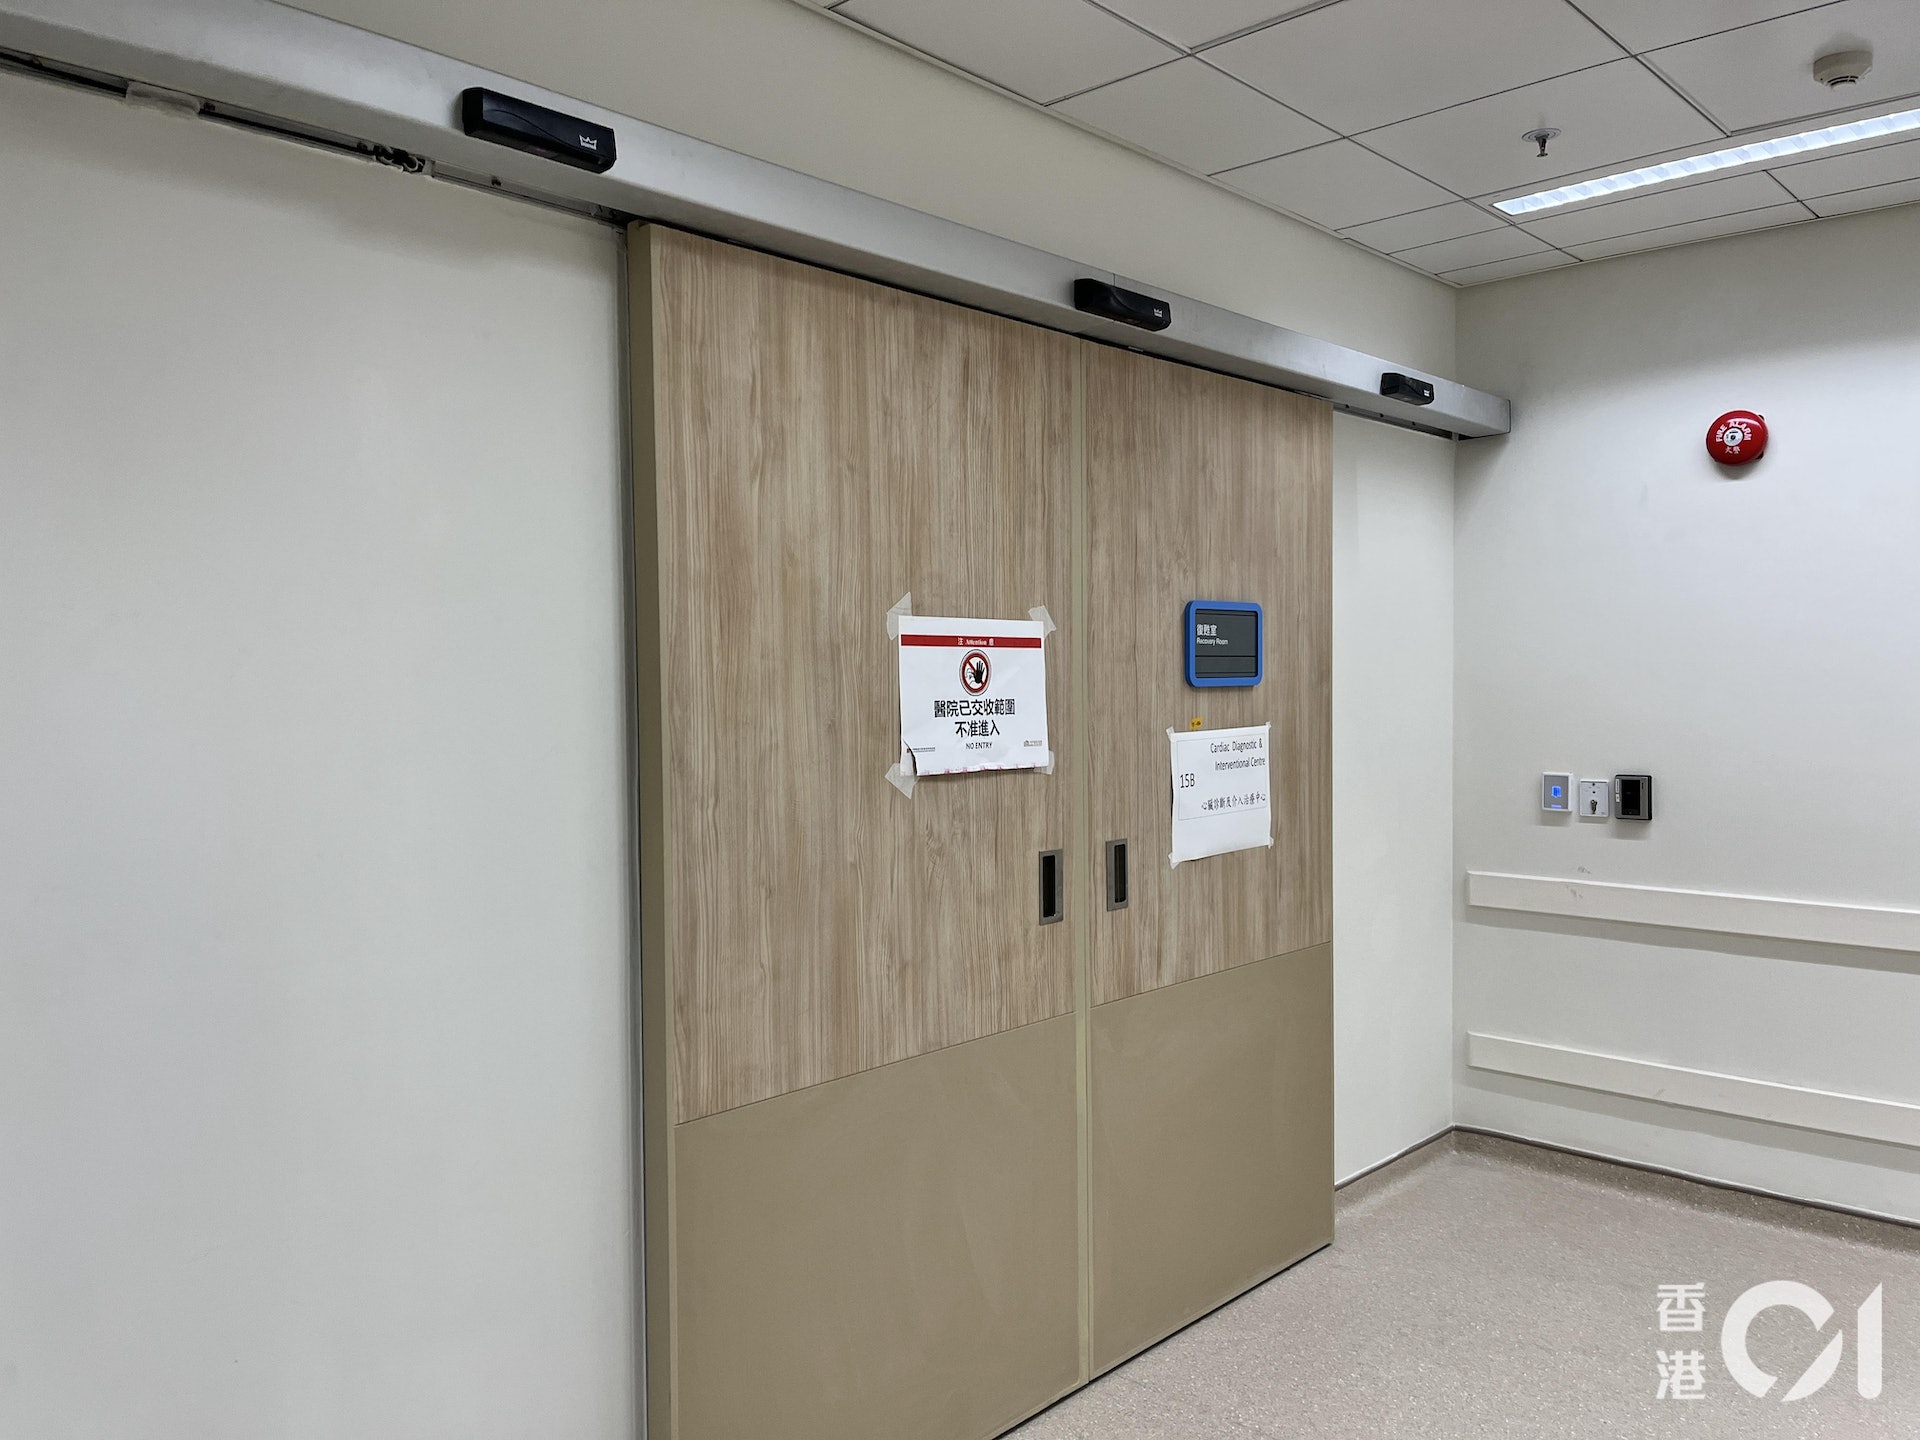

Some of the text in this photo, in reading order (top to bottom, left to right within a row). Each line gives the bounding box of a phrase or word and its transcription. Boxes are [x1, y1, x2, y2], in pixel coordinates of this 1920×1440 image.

[1716, 421, 1752, 442] FIRE ALARM
[1725, 446, 1741, 454] 火警
[965, 638, 987, 646] Attention
[1196, 637, 1215, 646] Recovery
[934, 698, 1016, 718] 醫院已交收範圍
[955, 719, 1000, 738] 不准進入
[966, 741, 993, 750] NO ENTRY
[1210, 738, 1263, 754] Cardiac Diagnostic &
[1215, 756, 1266, 771] Interventional Centre
[1179, 773, 1196, 789] 15B
[1201, 791, 1266, 811] 心臟診斷及介入治療中心
